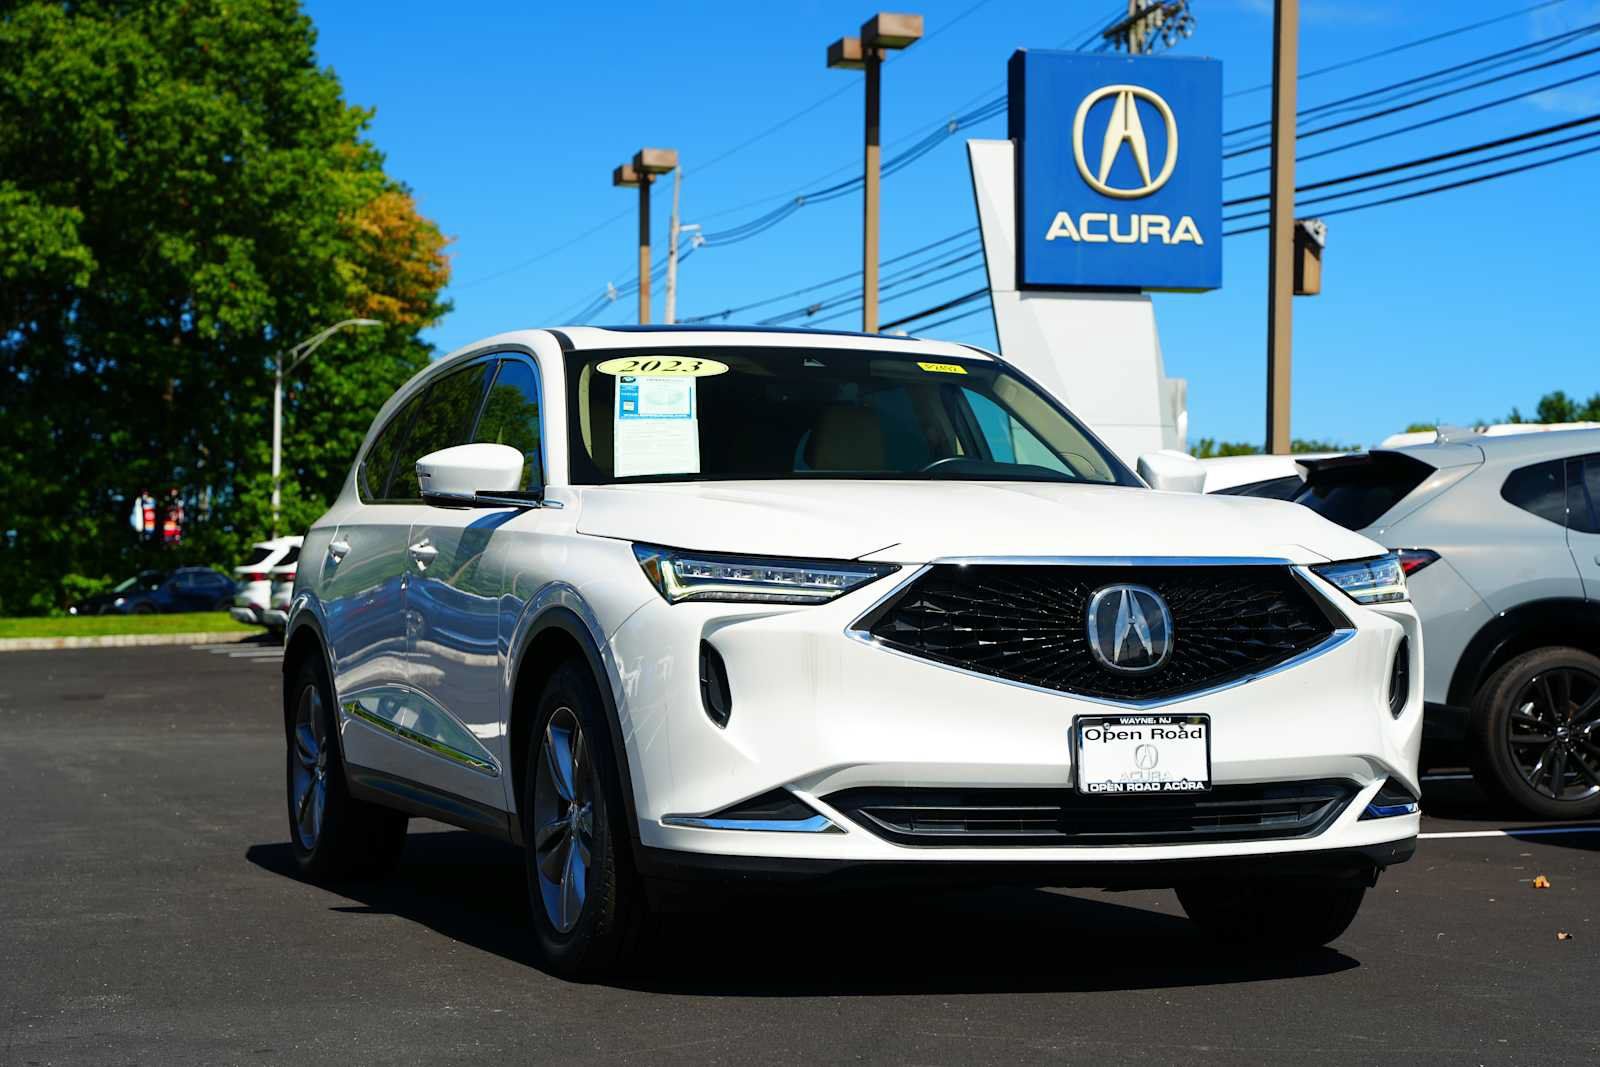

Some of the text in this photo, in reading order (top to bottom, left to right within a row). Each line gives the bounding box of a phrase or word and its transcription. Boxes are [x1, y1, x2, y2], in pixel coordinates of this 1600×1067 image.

[1045, 211, 1204, 245] ACURA
[620, 360, 703, 372] 2023
[1085, 728, 1202, 743] Open Road
[1090, 781, 1205, 792] OPEN ROAD ACURA
